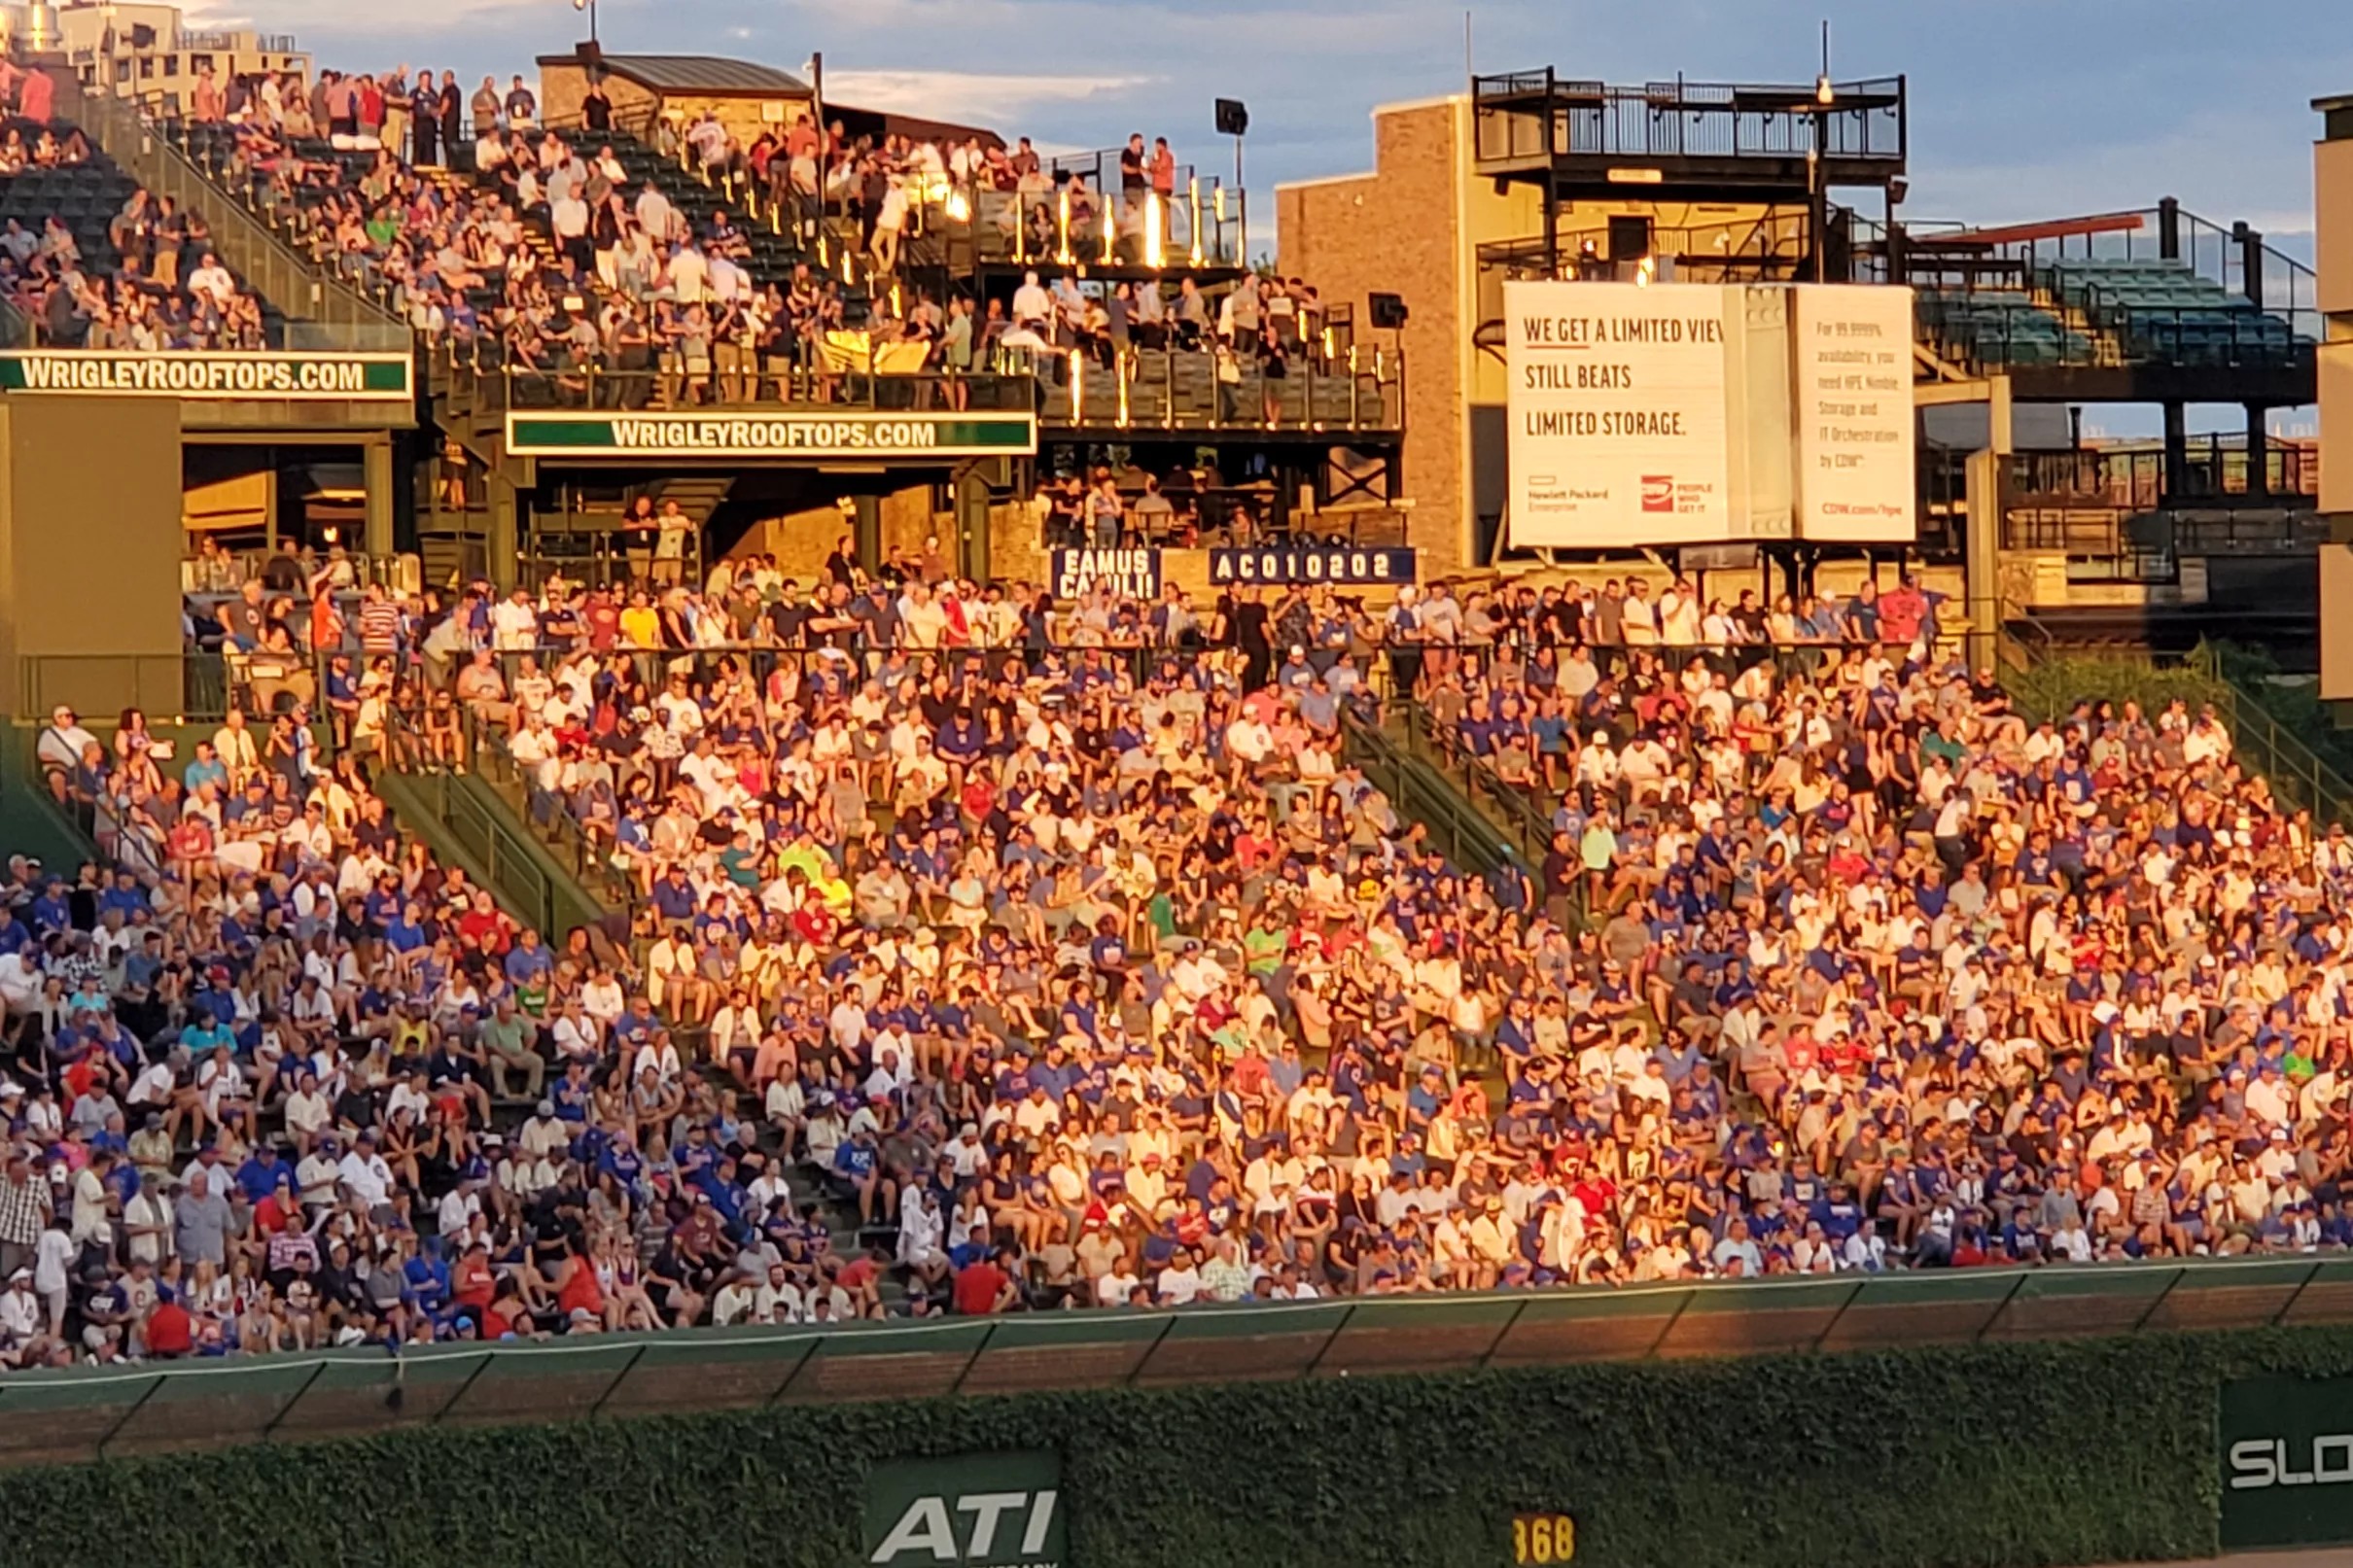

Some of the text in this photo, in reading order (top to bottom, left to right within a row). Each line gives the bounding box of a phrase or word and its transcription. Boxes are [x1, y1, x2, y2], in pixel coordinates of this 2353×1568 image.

[1524, 318, 1553, 342] WE
[1558, 318, 1590, 342] GET
[1596, 319, 1607, 342] A
[1611, 319, 1682, 342] LIMITED
[1526, 364, 1632, 389] STILL BEATS
[1527, 412, 1687, 436] LIMITED STORAGE.
[1064, 549, 1149, 575] EAMUS
[1060, 574, 1153, 599] CAULI!
[870, 1489, 1058, 1564] ATI
